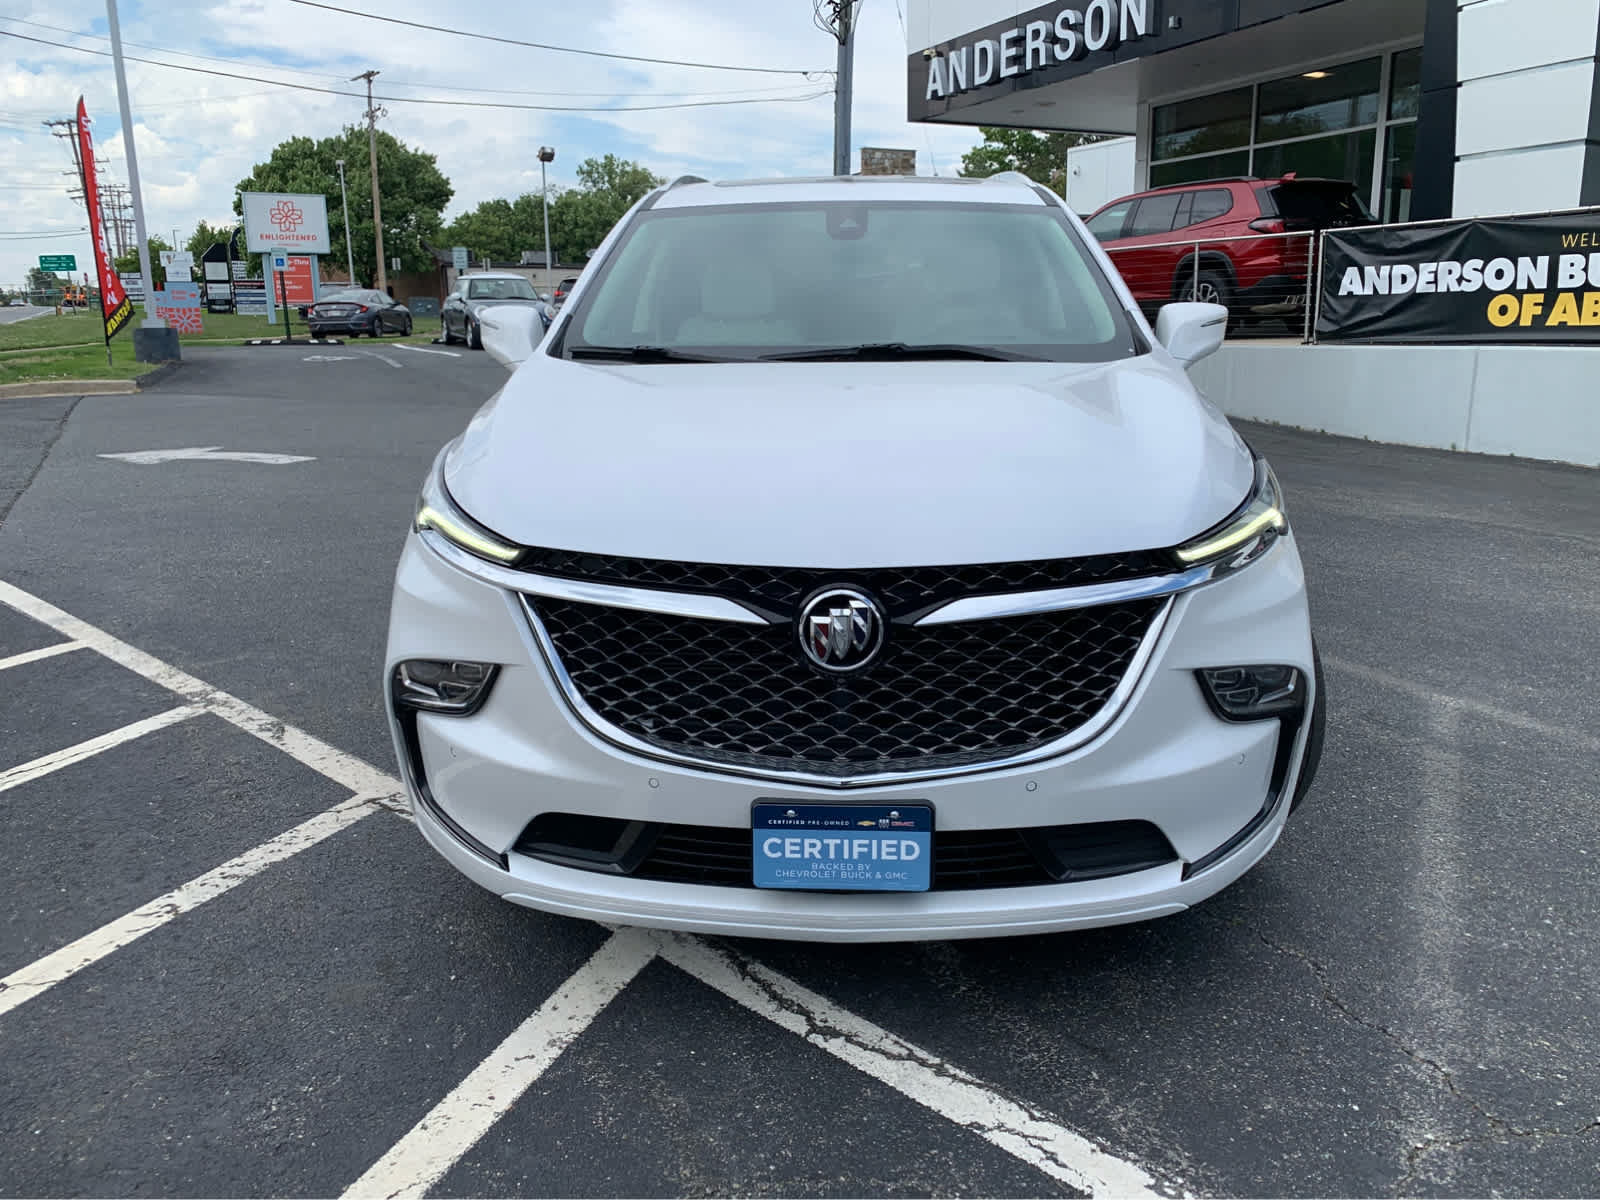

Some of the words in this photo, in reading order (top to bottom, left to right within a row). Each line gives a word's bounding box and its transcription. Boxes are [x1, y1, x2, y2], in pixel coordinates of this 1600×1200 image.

[925, 0, 1152, 100] ANDERSON
[259, 233, 318, 241] ENLIGHTENED
[1338, 255, 1550, 296] ANDERSON
[1486, 292, 1545, 328] OF
[762, 837, 921, 861] CERTIFIED
[775, 869, 836, 879] CHEVROLET
[840, 870, 872, 879] BUICK
[874, 871, 882, 879] &
[885, 871, 908, 880] GMC
[811, 862, 854, 871] BACKED
[857, 863, 871, 871] BY
